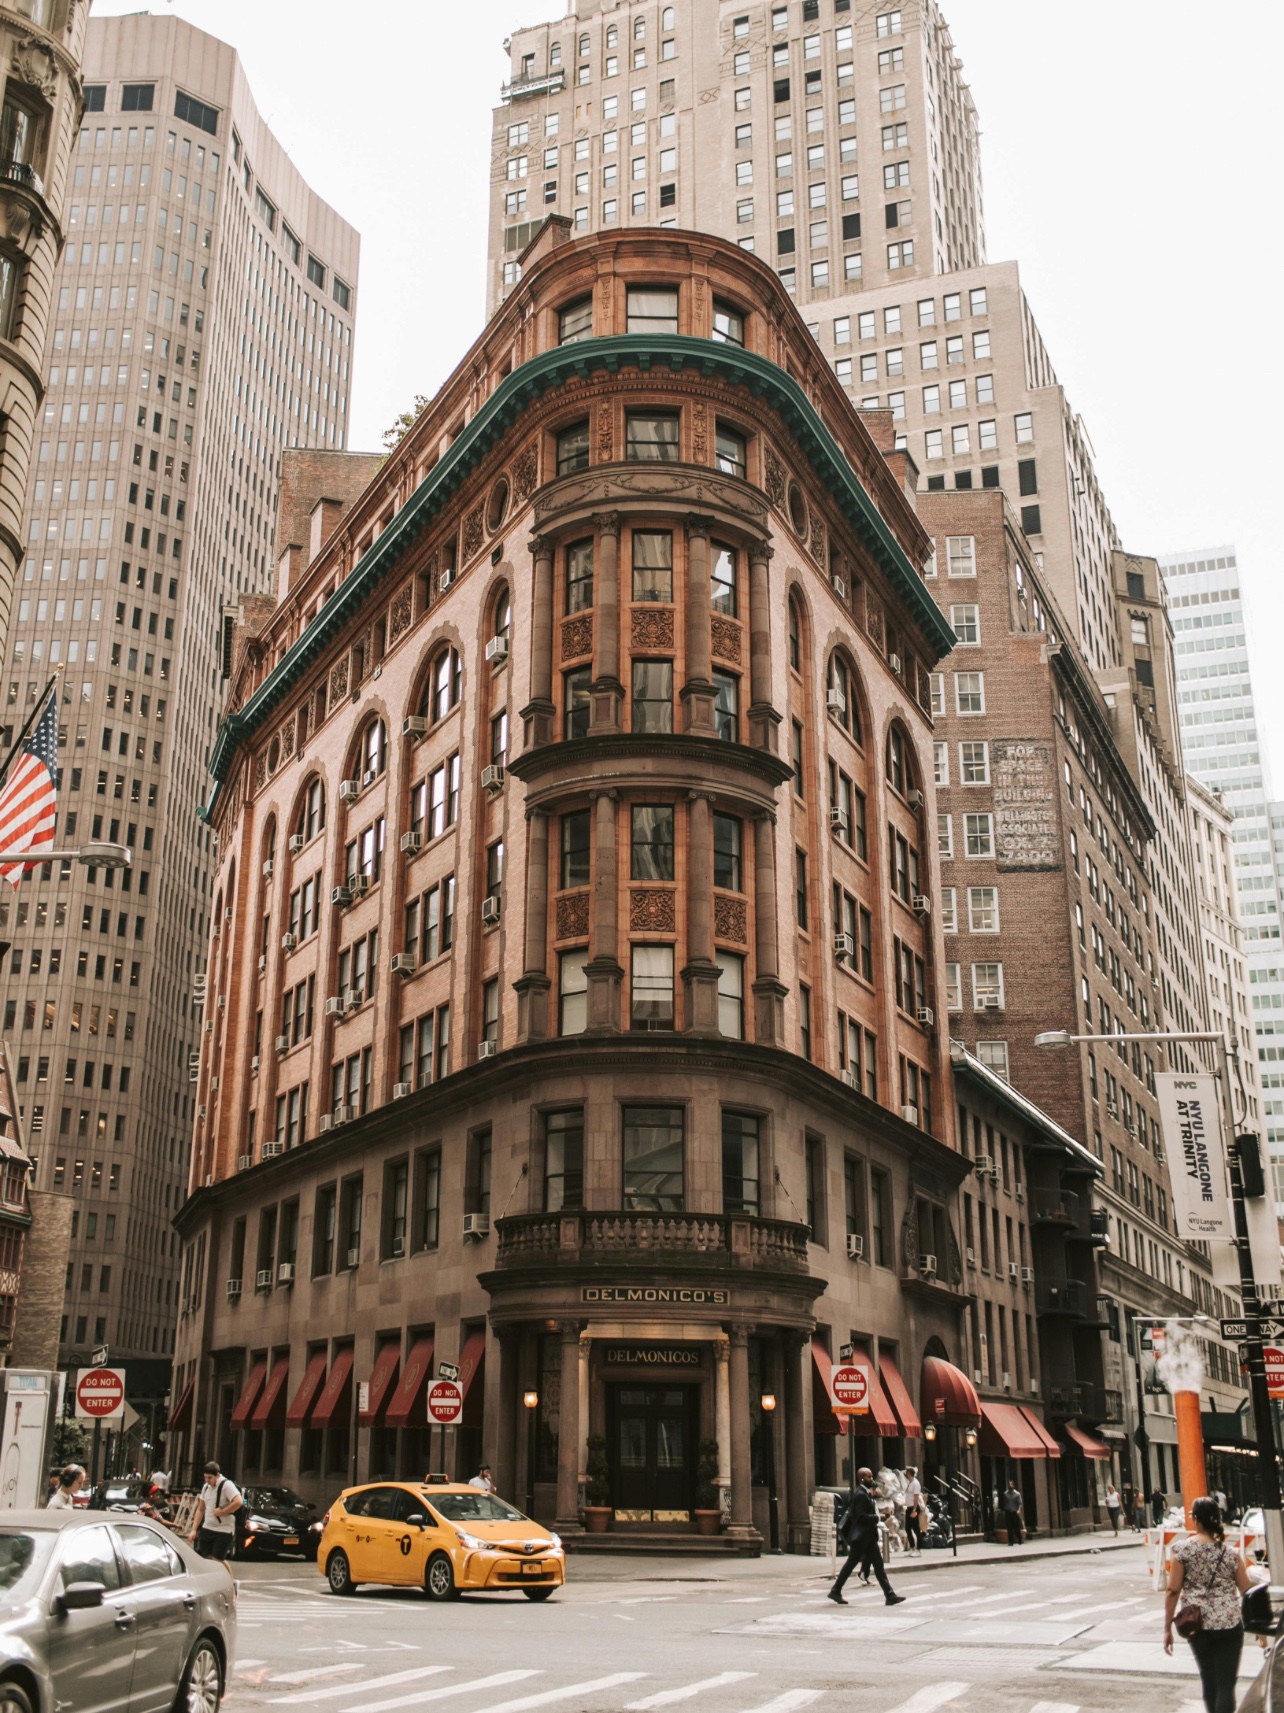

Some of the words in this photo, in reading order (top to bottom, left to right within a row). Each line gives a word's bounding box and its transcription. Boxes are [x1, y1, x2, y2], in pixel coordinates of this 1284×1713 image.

[1173, 1081, 1197, 1090] NYC
[1176, 1099, 1190, 1118] AT
[1188, 1100, 1204, 1130] NYU
[1180, 1121, 1199, 1179] TRINITY
[1193, 1134, 1213, 1202] LANGONE
[1188, 1217, 1200, 1225] NYU
[1200, 1218, 1223, 1227] Langone
[586, 1289, 725, 1303] DELMONICO'S
[1226, 1325, 1246, 1334] ONE
[87, 1399, 113, 1407] ENTER
